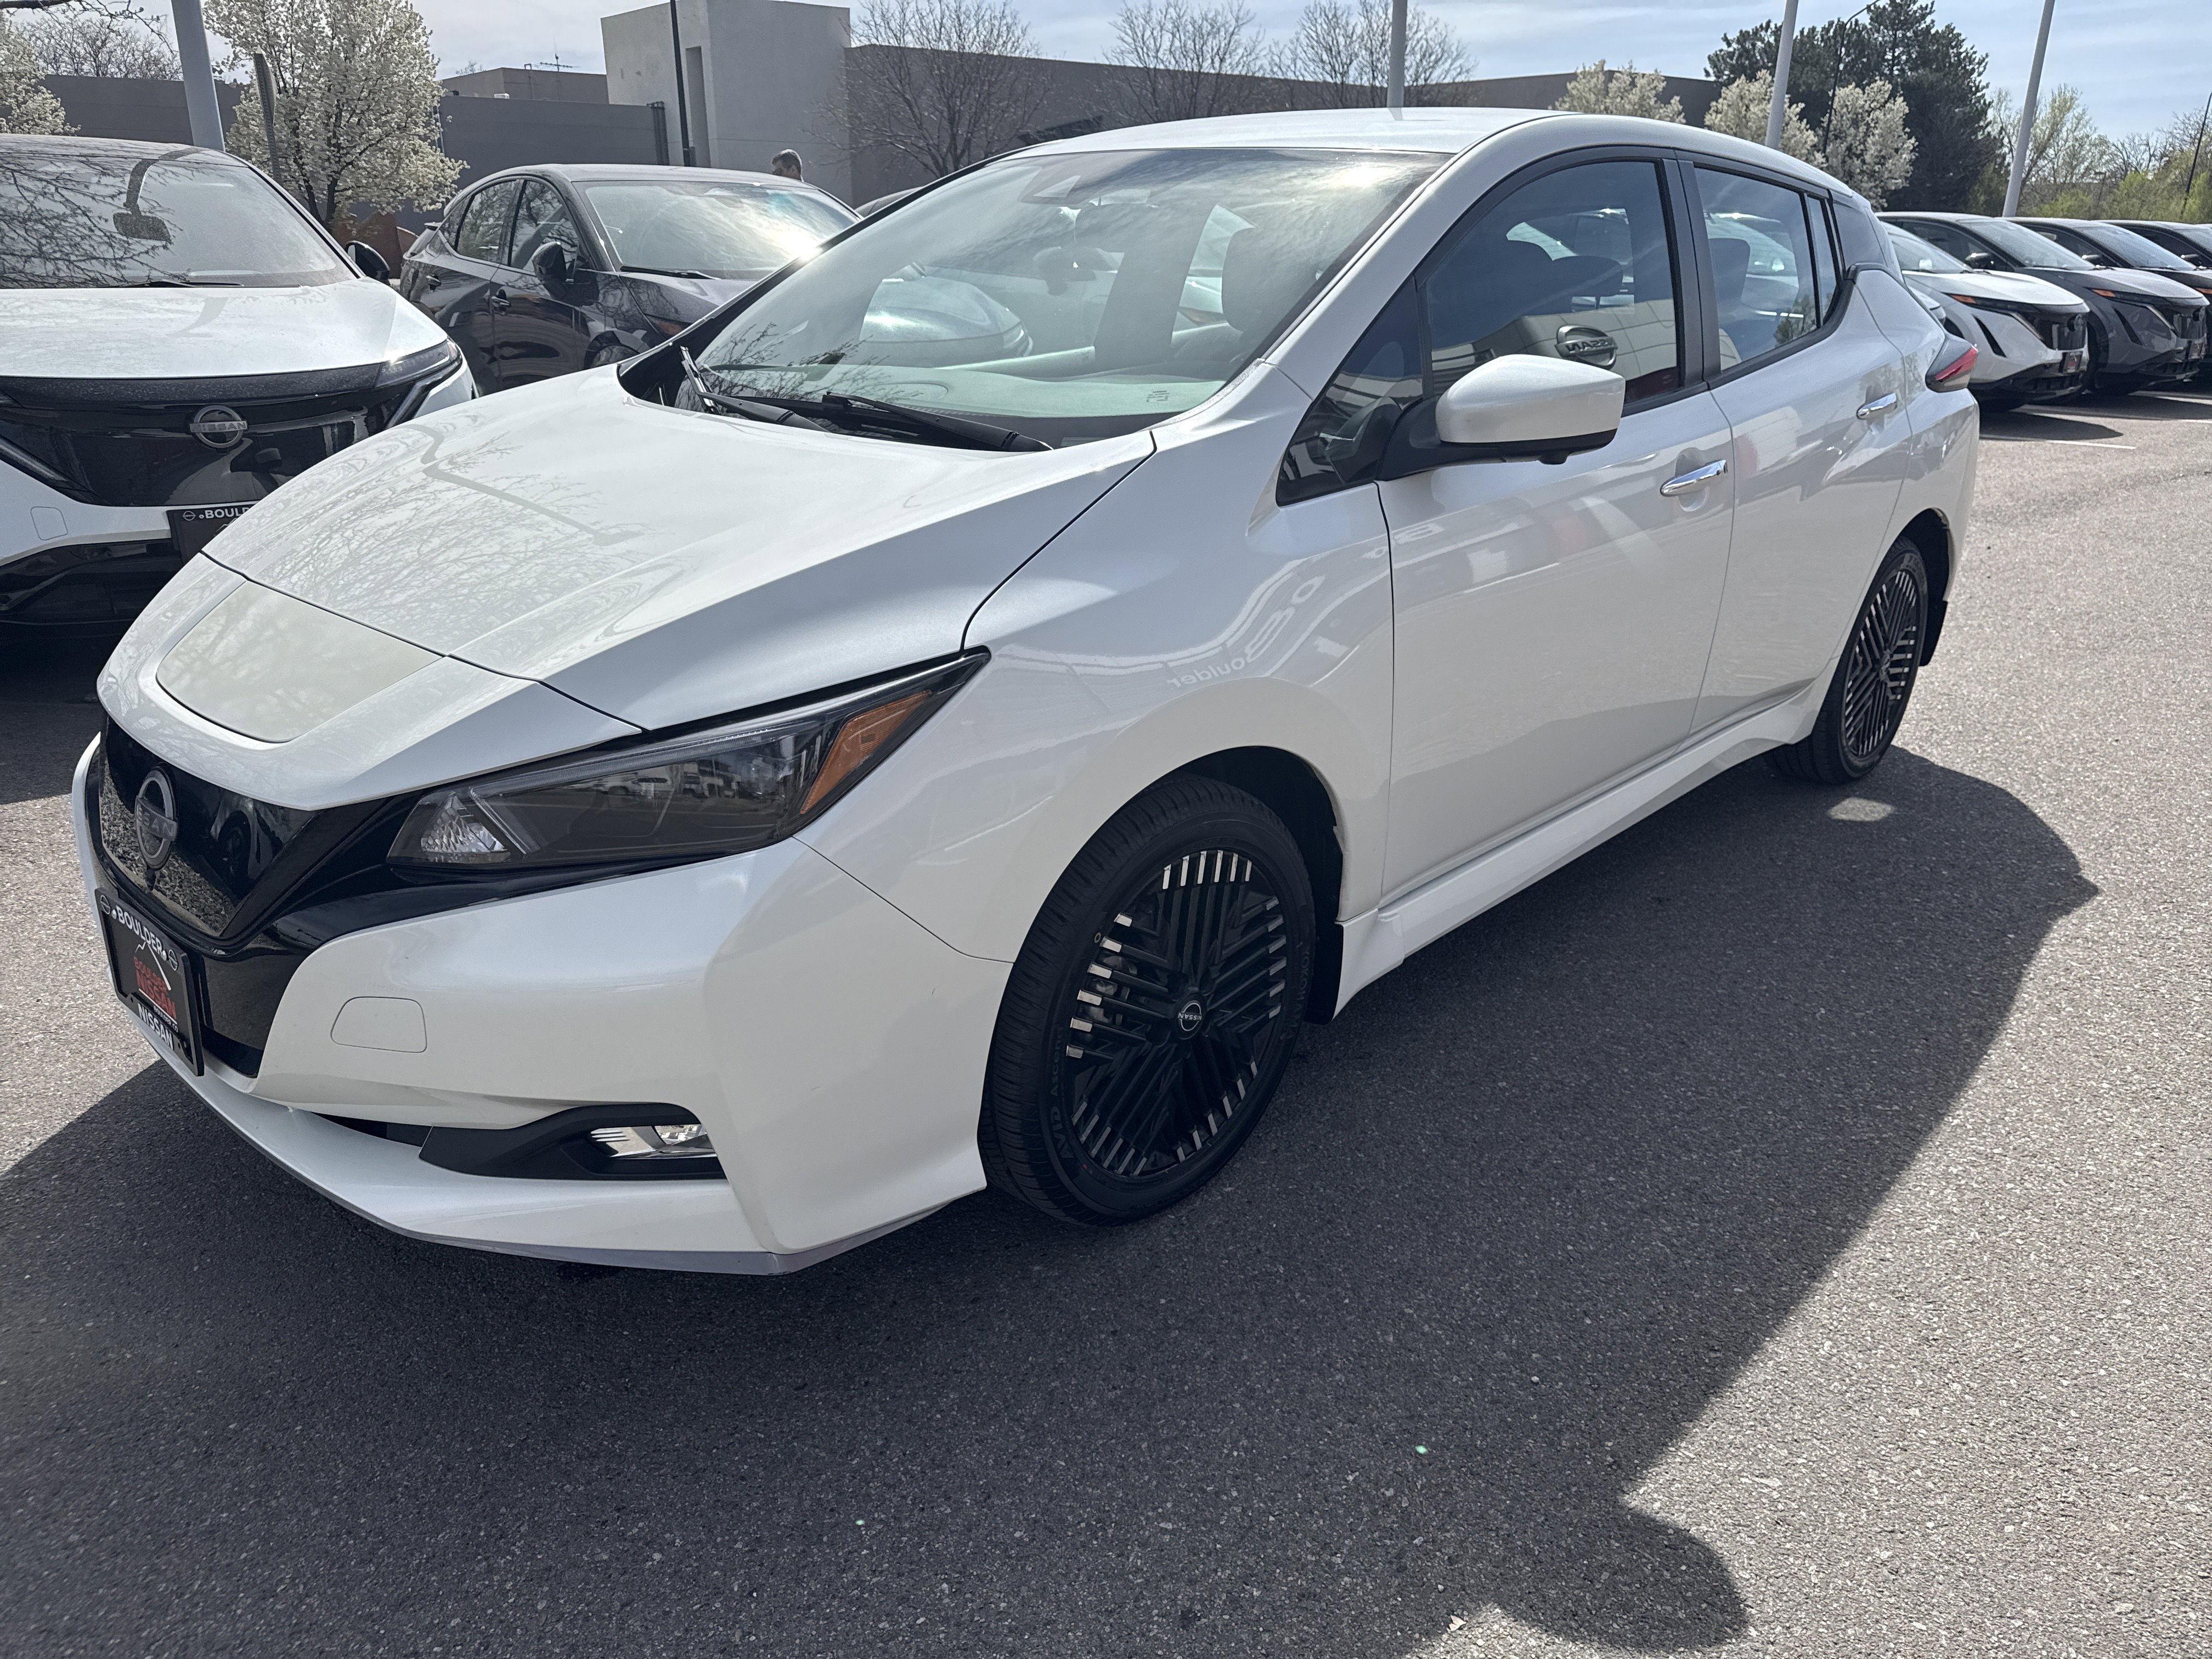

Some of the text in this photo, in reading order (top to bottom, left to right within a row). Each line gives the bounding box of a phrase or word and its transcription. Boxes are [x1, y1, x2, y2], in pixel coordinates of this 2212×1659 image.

[192, 421, 246, 432] NISSAN
[116, 905, 163, 955] BOULDER
[137, 1002, 173, 1051] NISSAN
[1177, 1012, 1203, 1021] NISSAN
